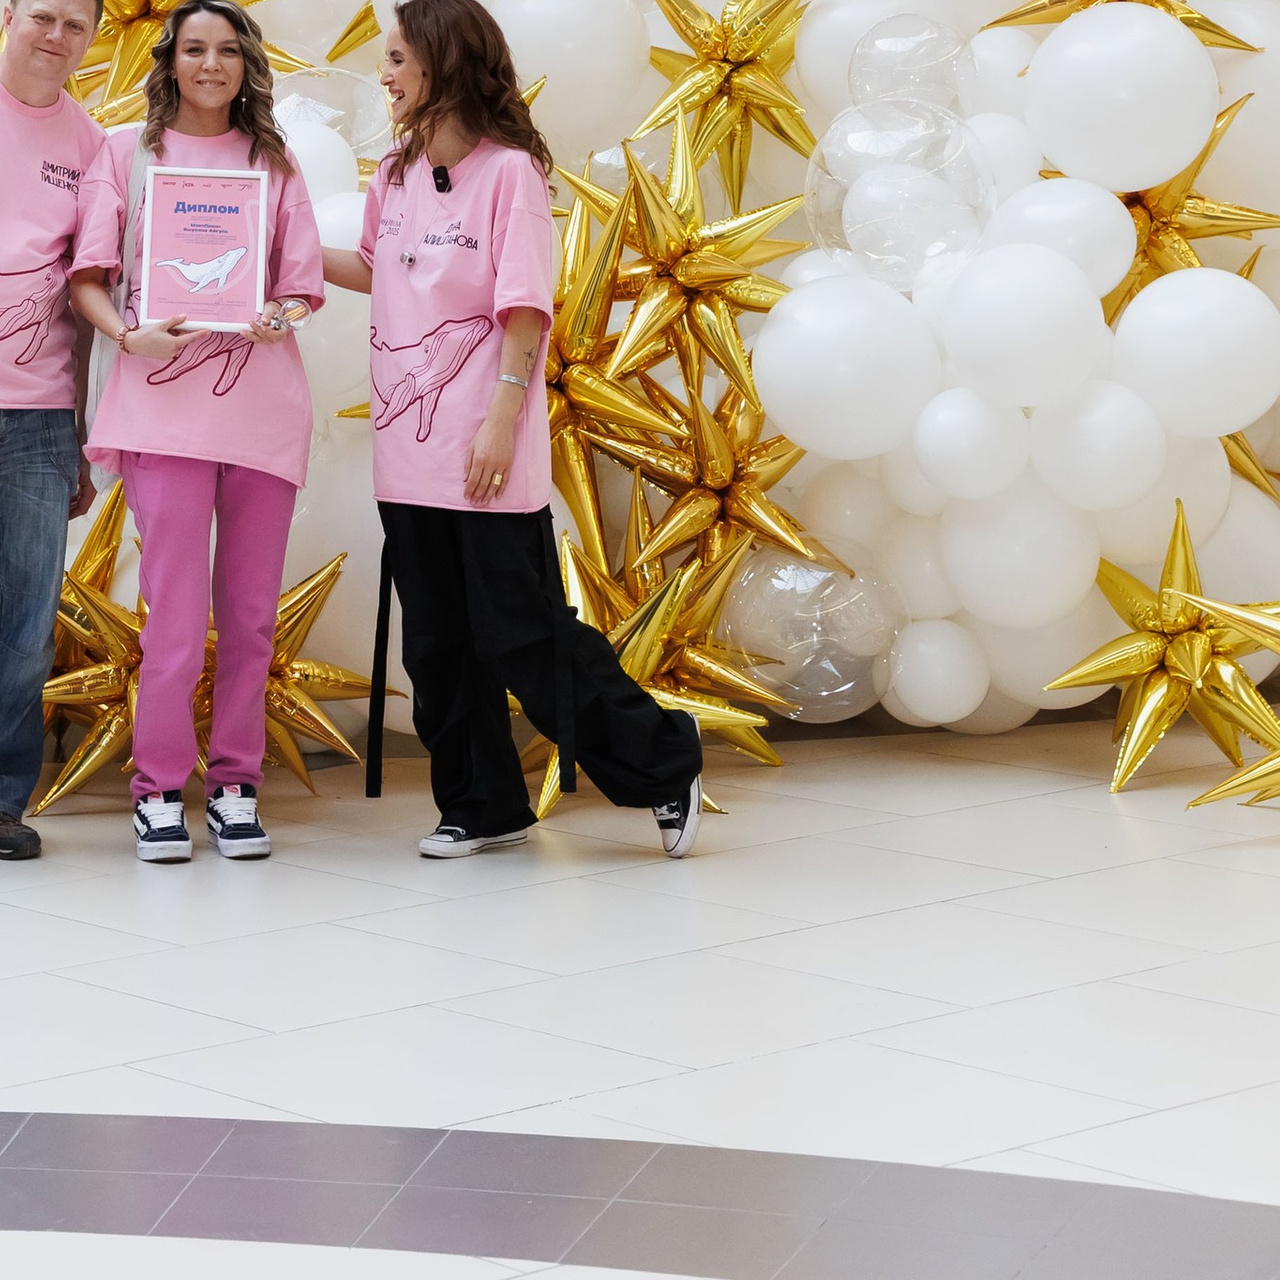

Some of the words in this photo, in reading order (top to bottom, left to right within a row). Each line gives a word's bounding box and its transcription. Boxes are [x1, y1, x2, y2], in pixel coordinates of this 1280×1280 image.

[42, 160, 81, 182] ДМИТРИЙ
[40, 170, 80, 195] ТИЩЕНКО
[174, 201, 240, 214] Диплом
